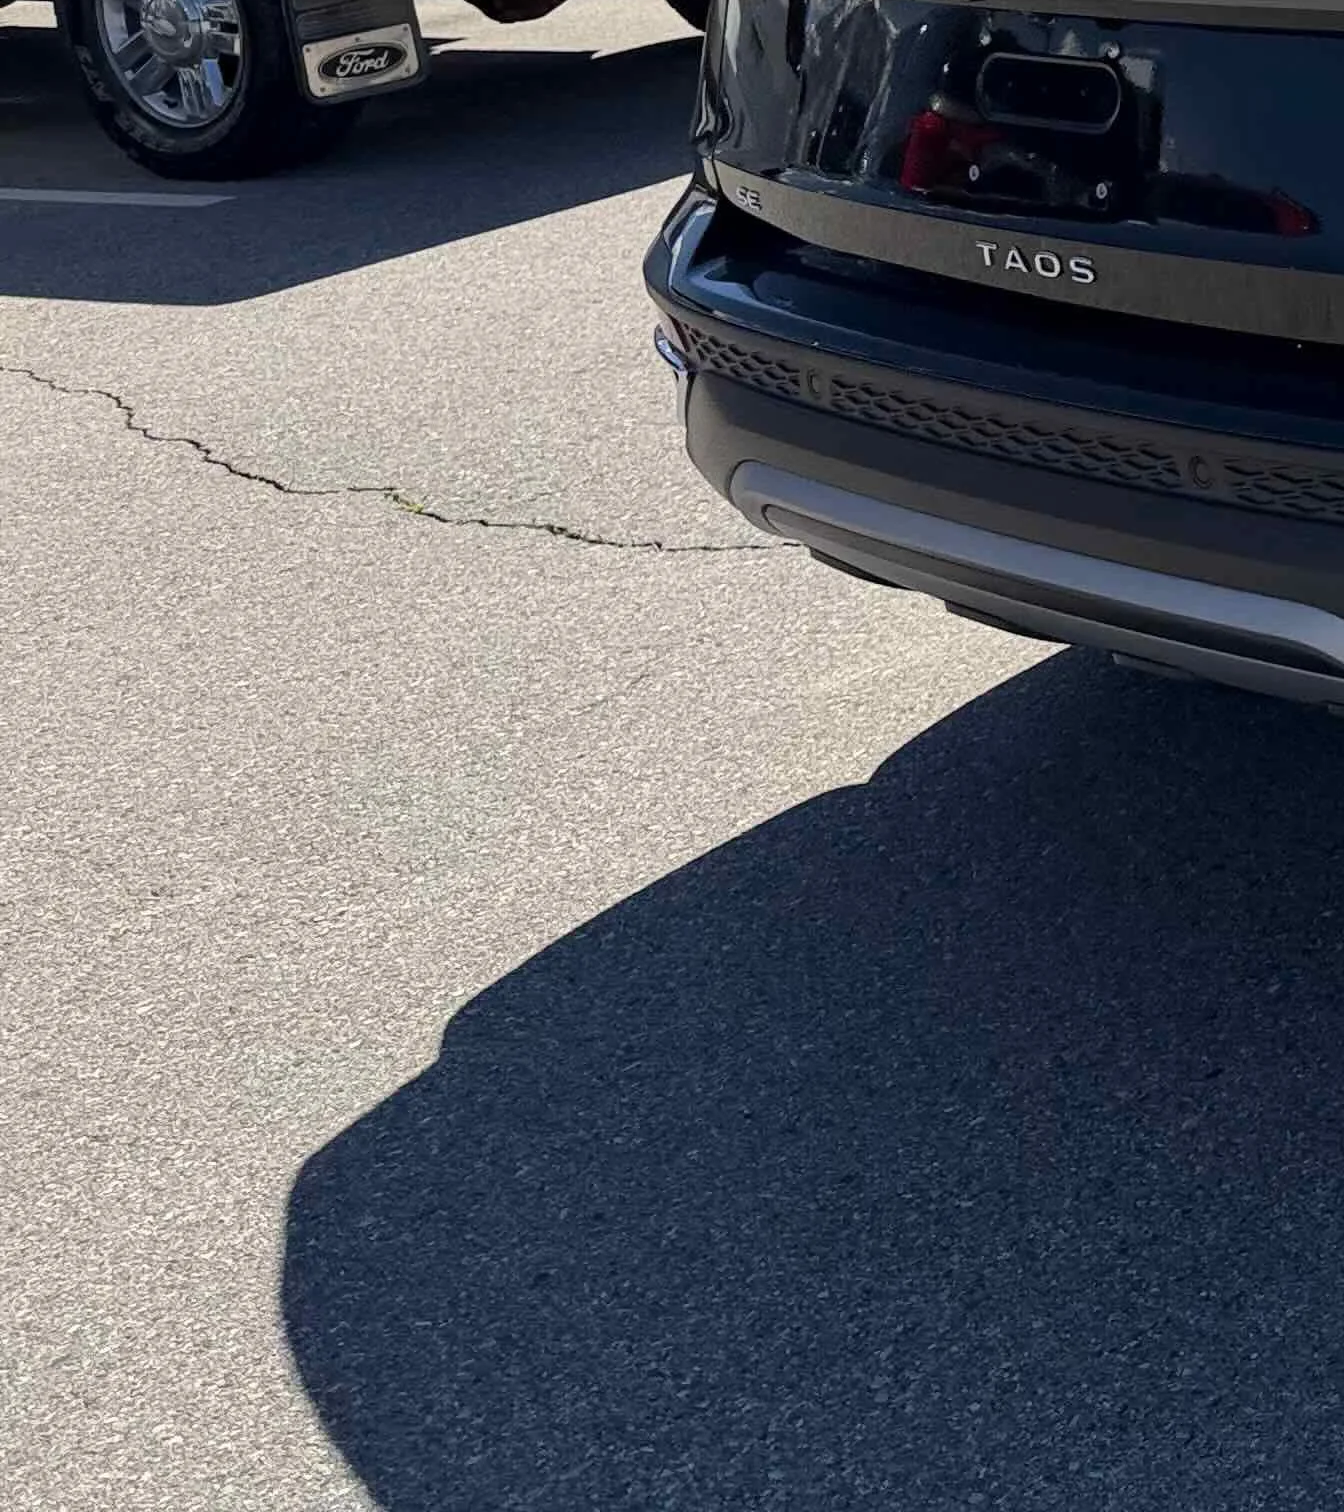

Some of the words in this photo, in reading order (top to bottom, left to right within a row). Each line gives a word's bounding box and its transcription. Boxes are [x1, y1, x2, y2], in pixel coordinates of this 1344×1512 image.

[336, 48, 389, 77] Ford
[735, 187, 761, 209] SE
[975, 240, 1096, 284] TAOS
